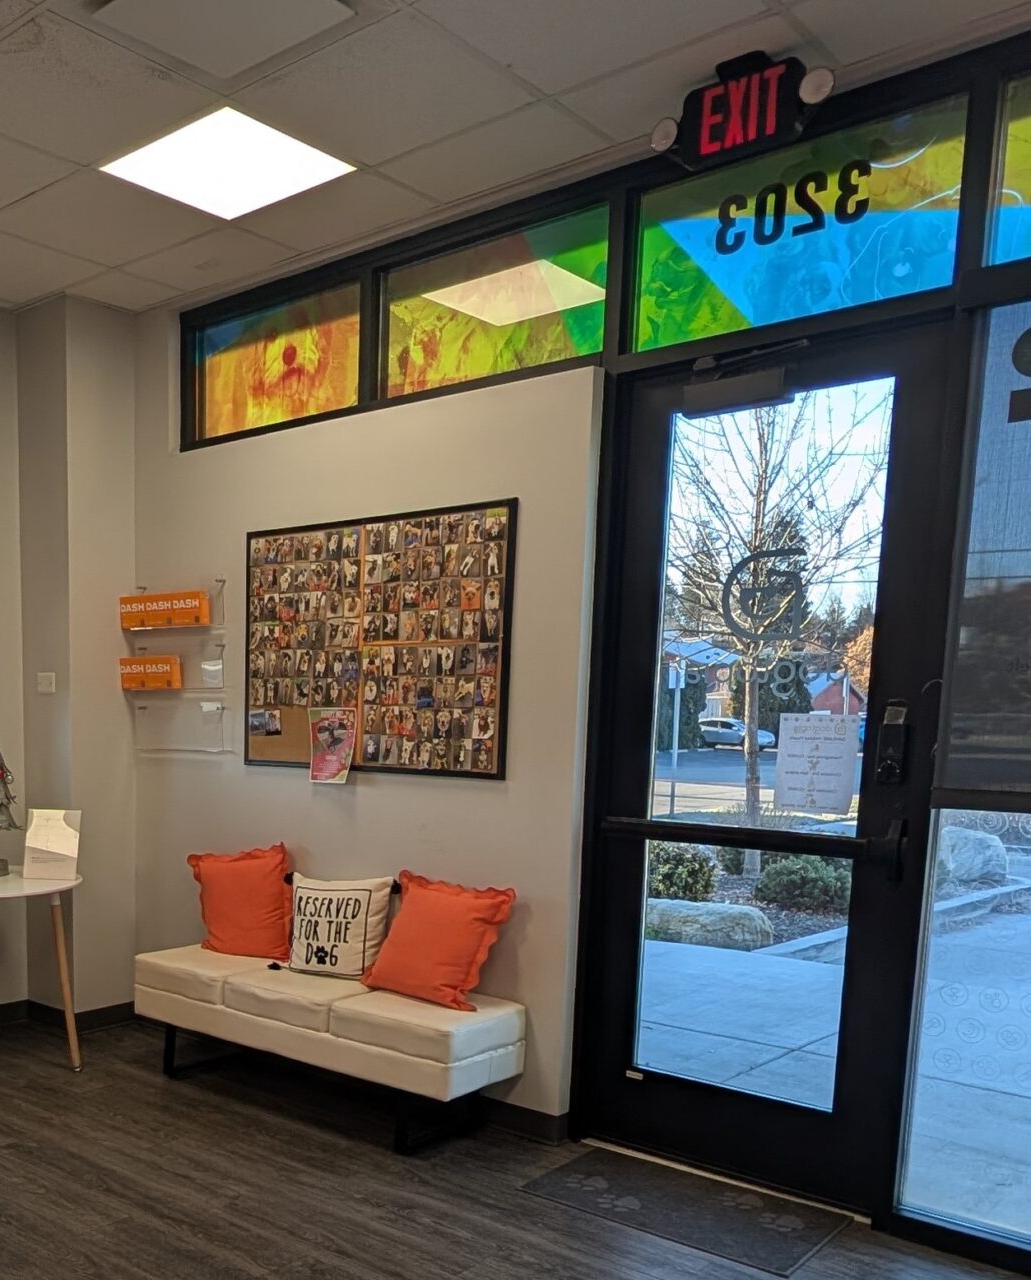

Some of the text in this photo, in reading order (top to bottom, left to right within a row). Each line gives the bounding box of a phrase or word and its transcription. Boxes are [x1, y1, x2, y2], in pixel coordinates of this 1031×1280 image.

[698, 63, 786, 156] EXIT
[120, 599, 199, 613] DASH DASH DASH
[120, 663, 170, 673] DASH DASH
[296, 895, 361, 920] RESERVED
[298, 918, 352, 944] FOR THE
[305, 942, 339, 966] DG
